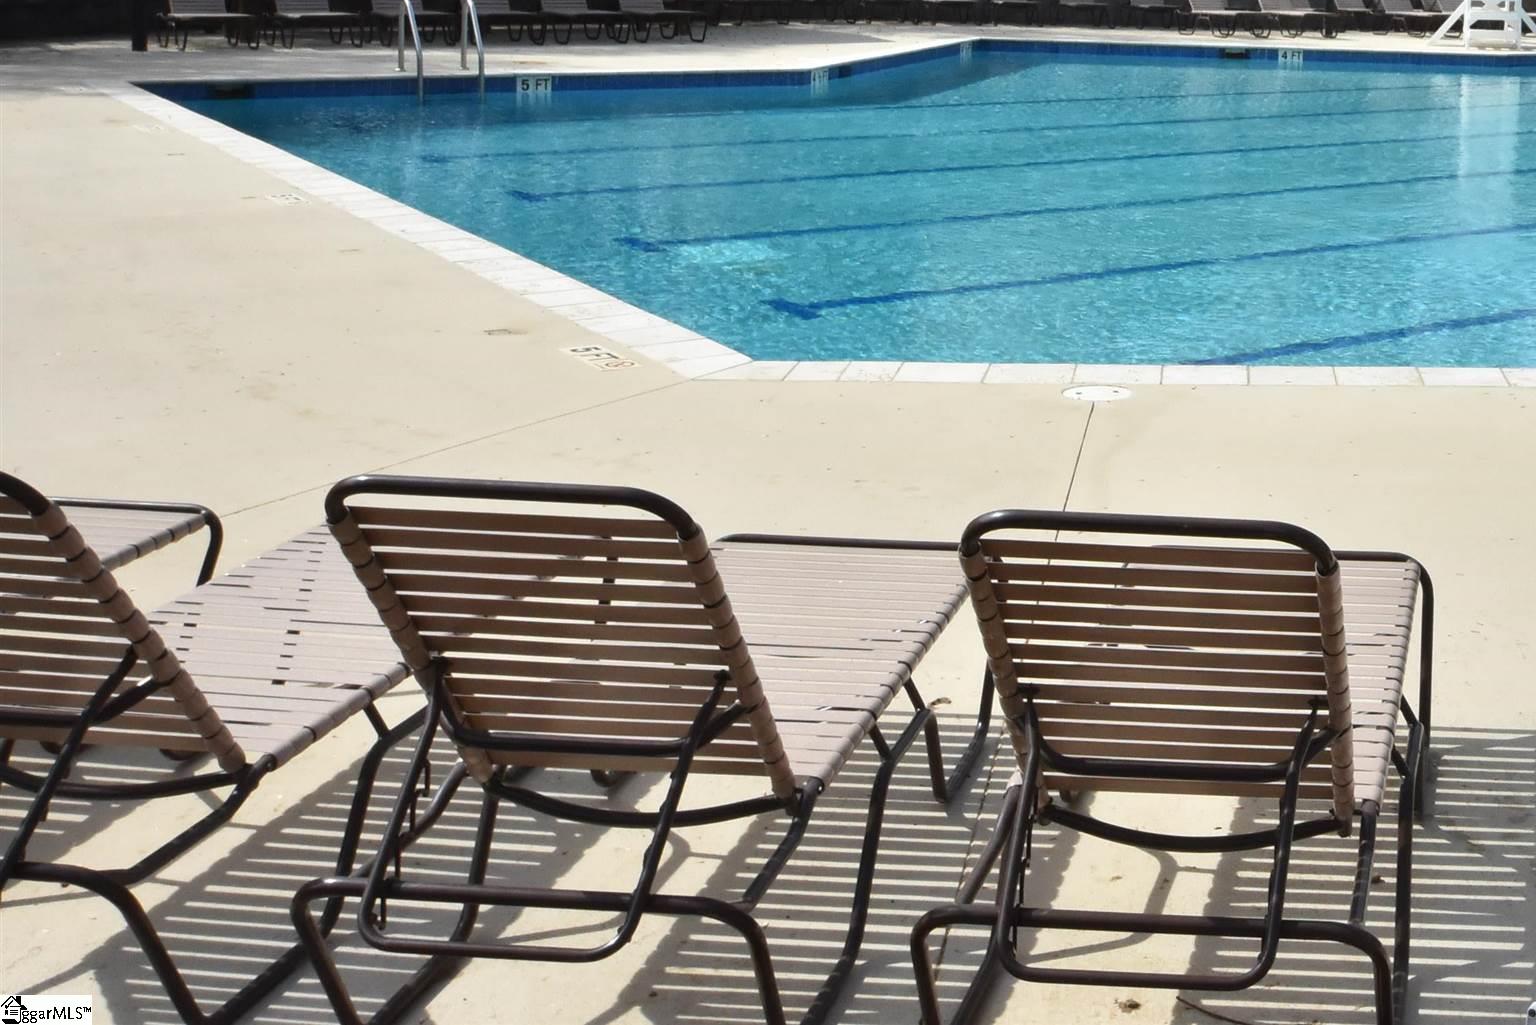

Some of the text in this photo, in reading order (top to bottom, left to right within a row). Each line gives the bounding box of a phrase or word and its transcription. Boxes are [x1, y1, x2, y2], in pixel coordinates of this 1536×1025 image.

[1281, 50, 1301, 60] 4 FT
[521, 78, 550, 91] 5 FT
